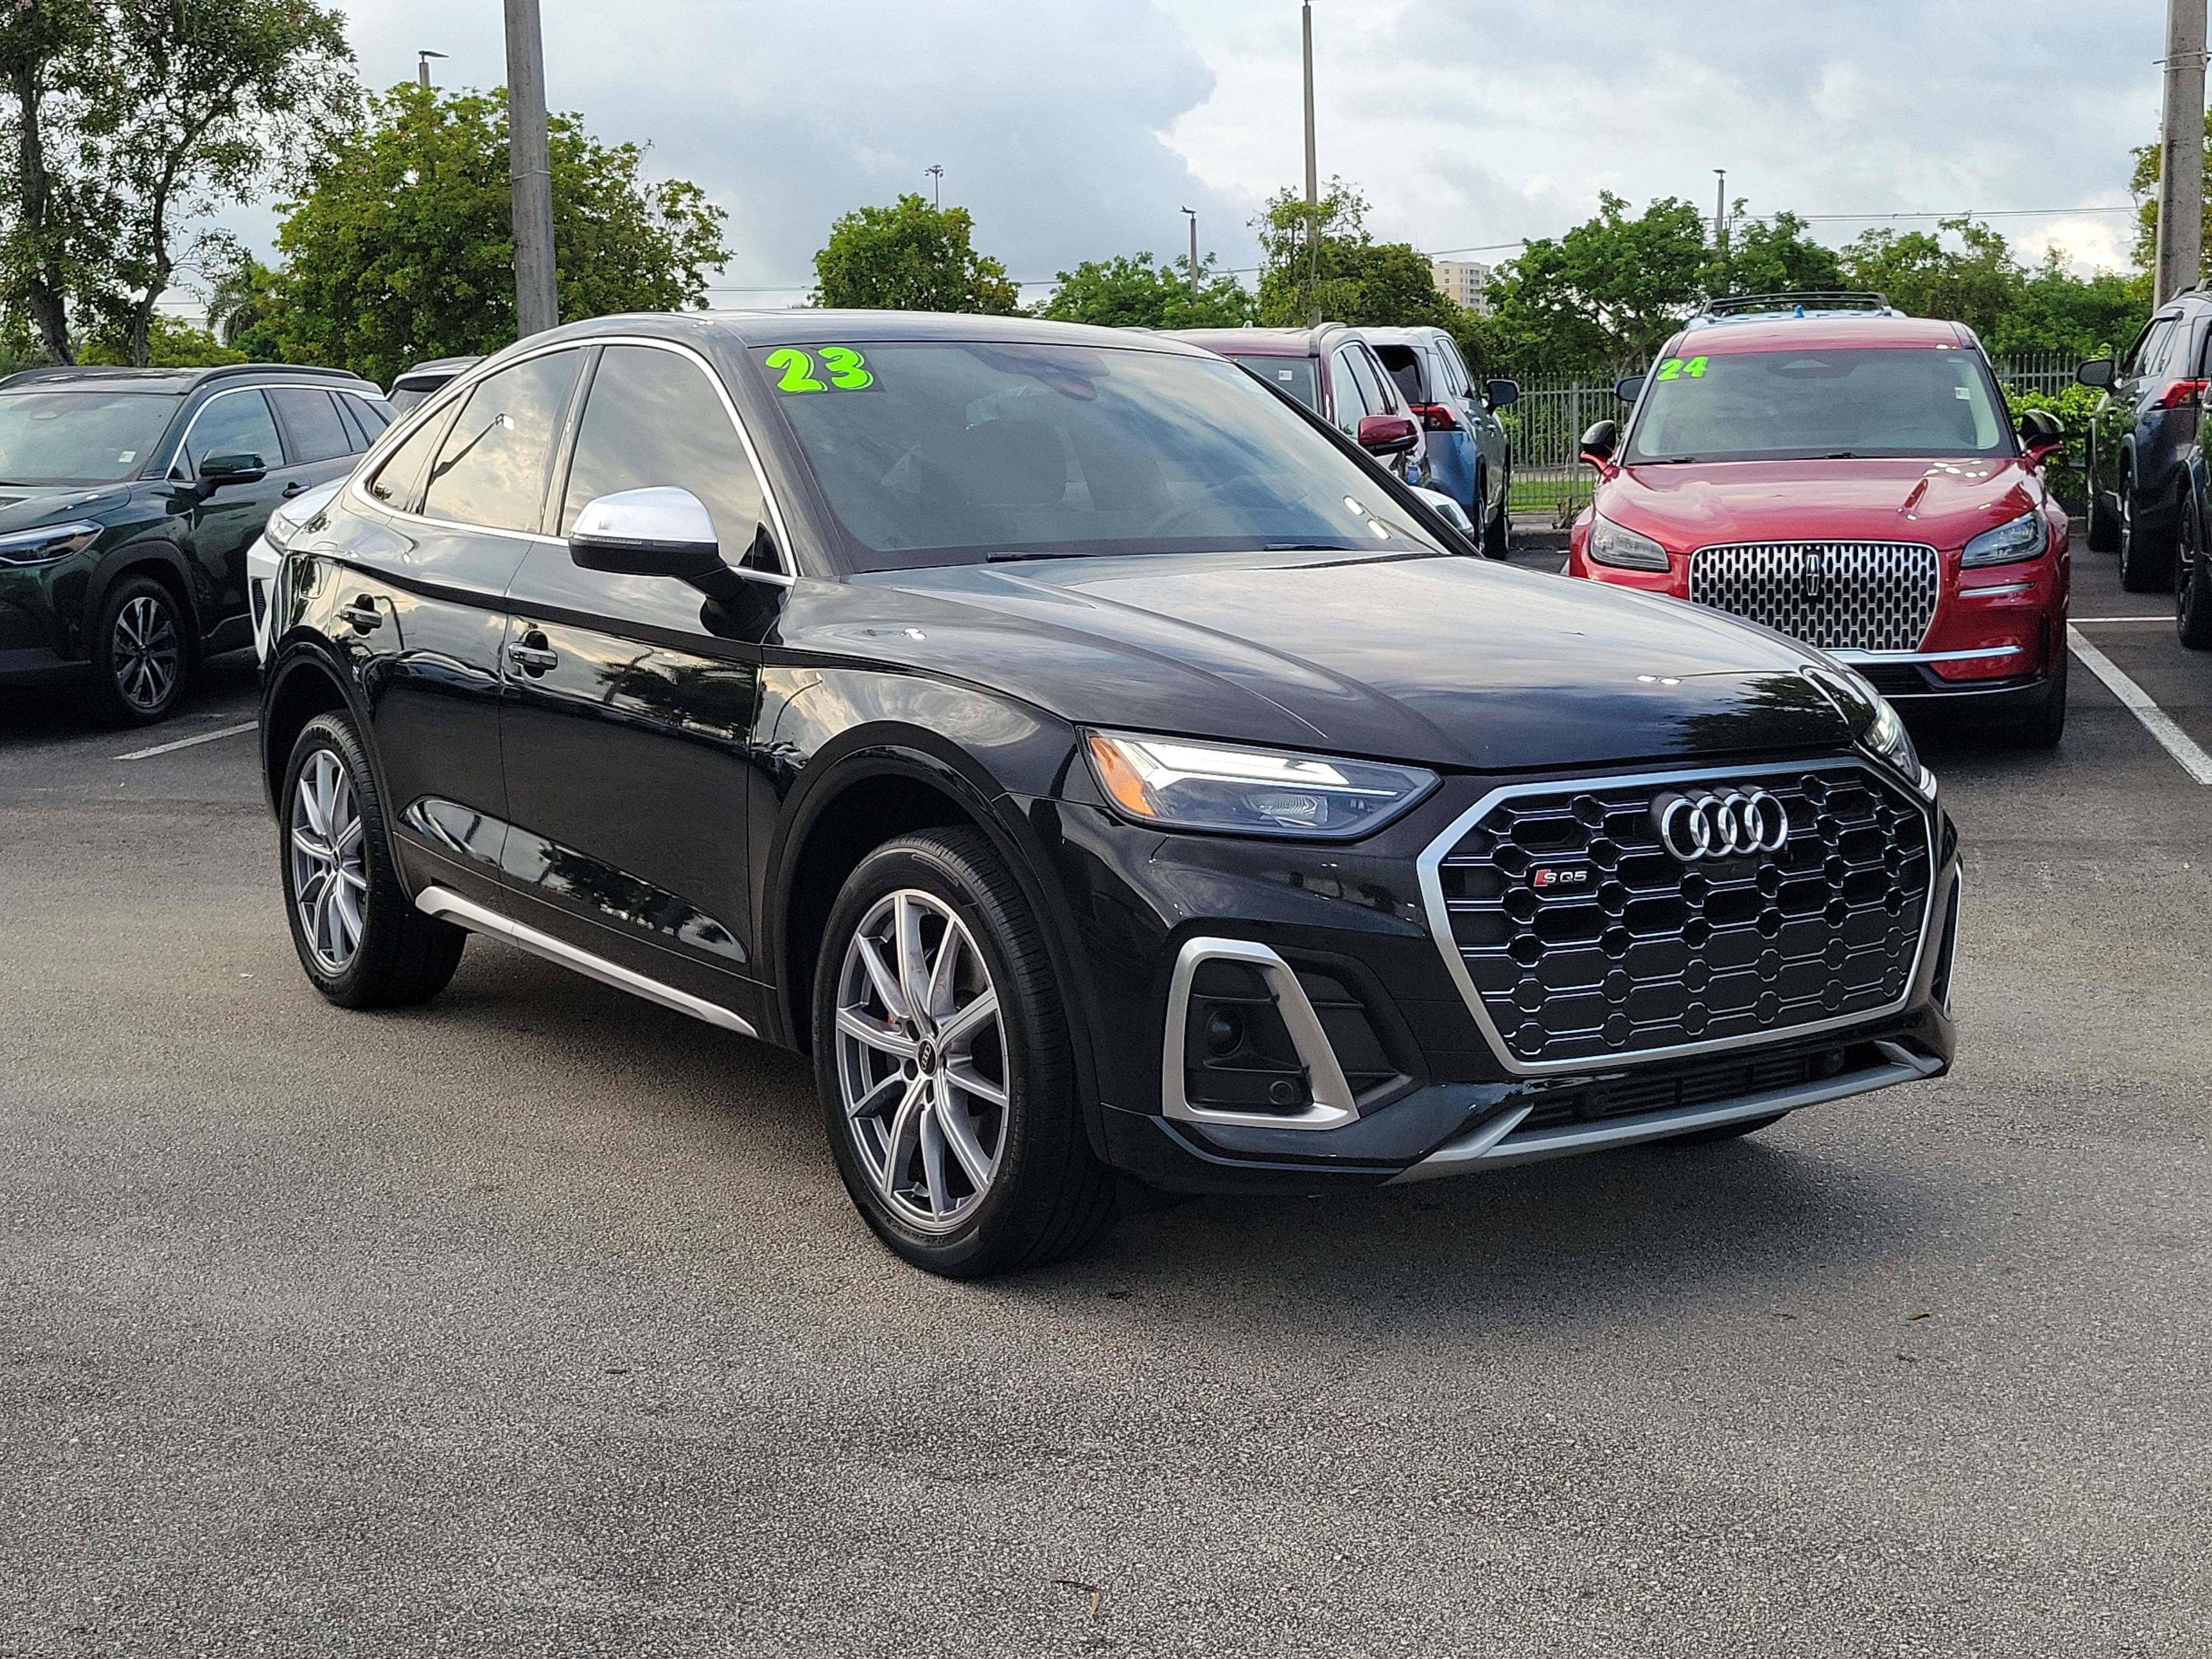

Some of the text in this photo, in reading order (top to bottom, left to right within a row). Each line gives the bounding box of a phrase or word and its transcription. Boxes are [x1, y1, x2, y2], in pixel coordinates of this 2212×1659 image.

[765, 346, 874, 393] 23
[1656, 356, 1708, 381] 24
[1543, 871, 1587, 884] SQ5
